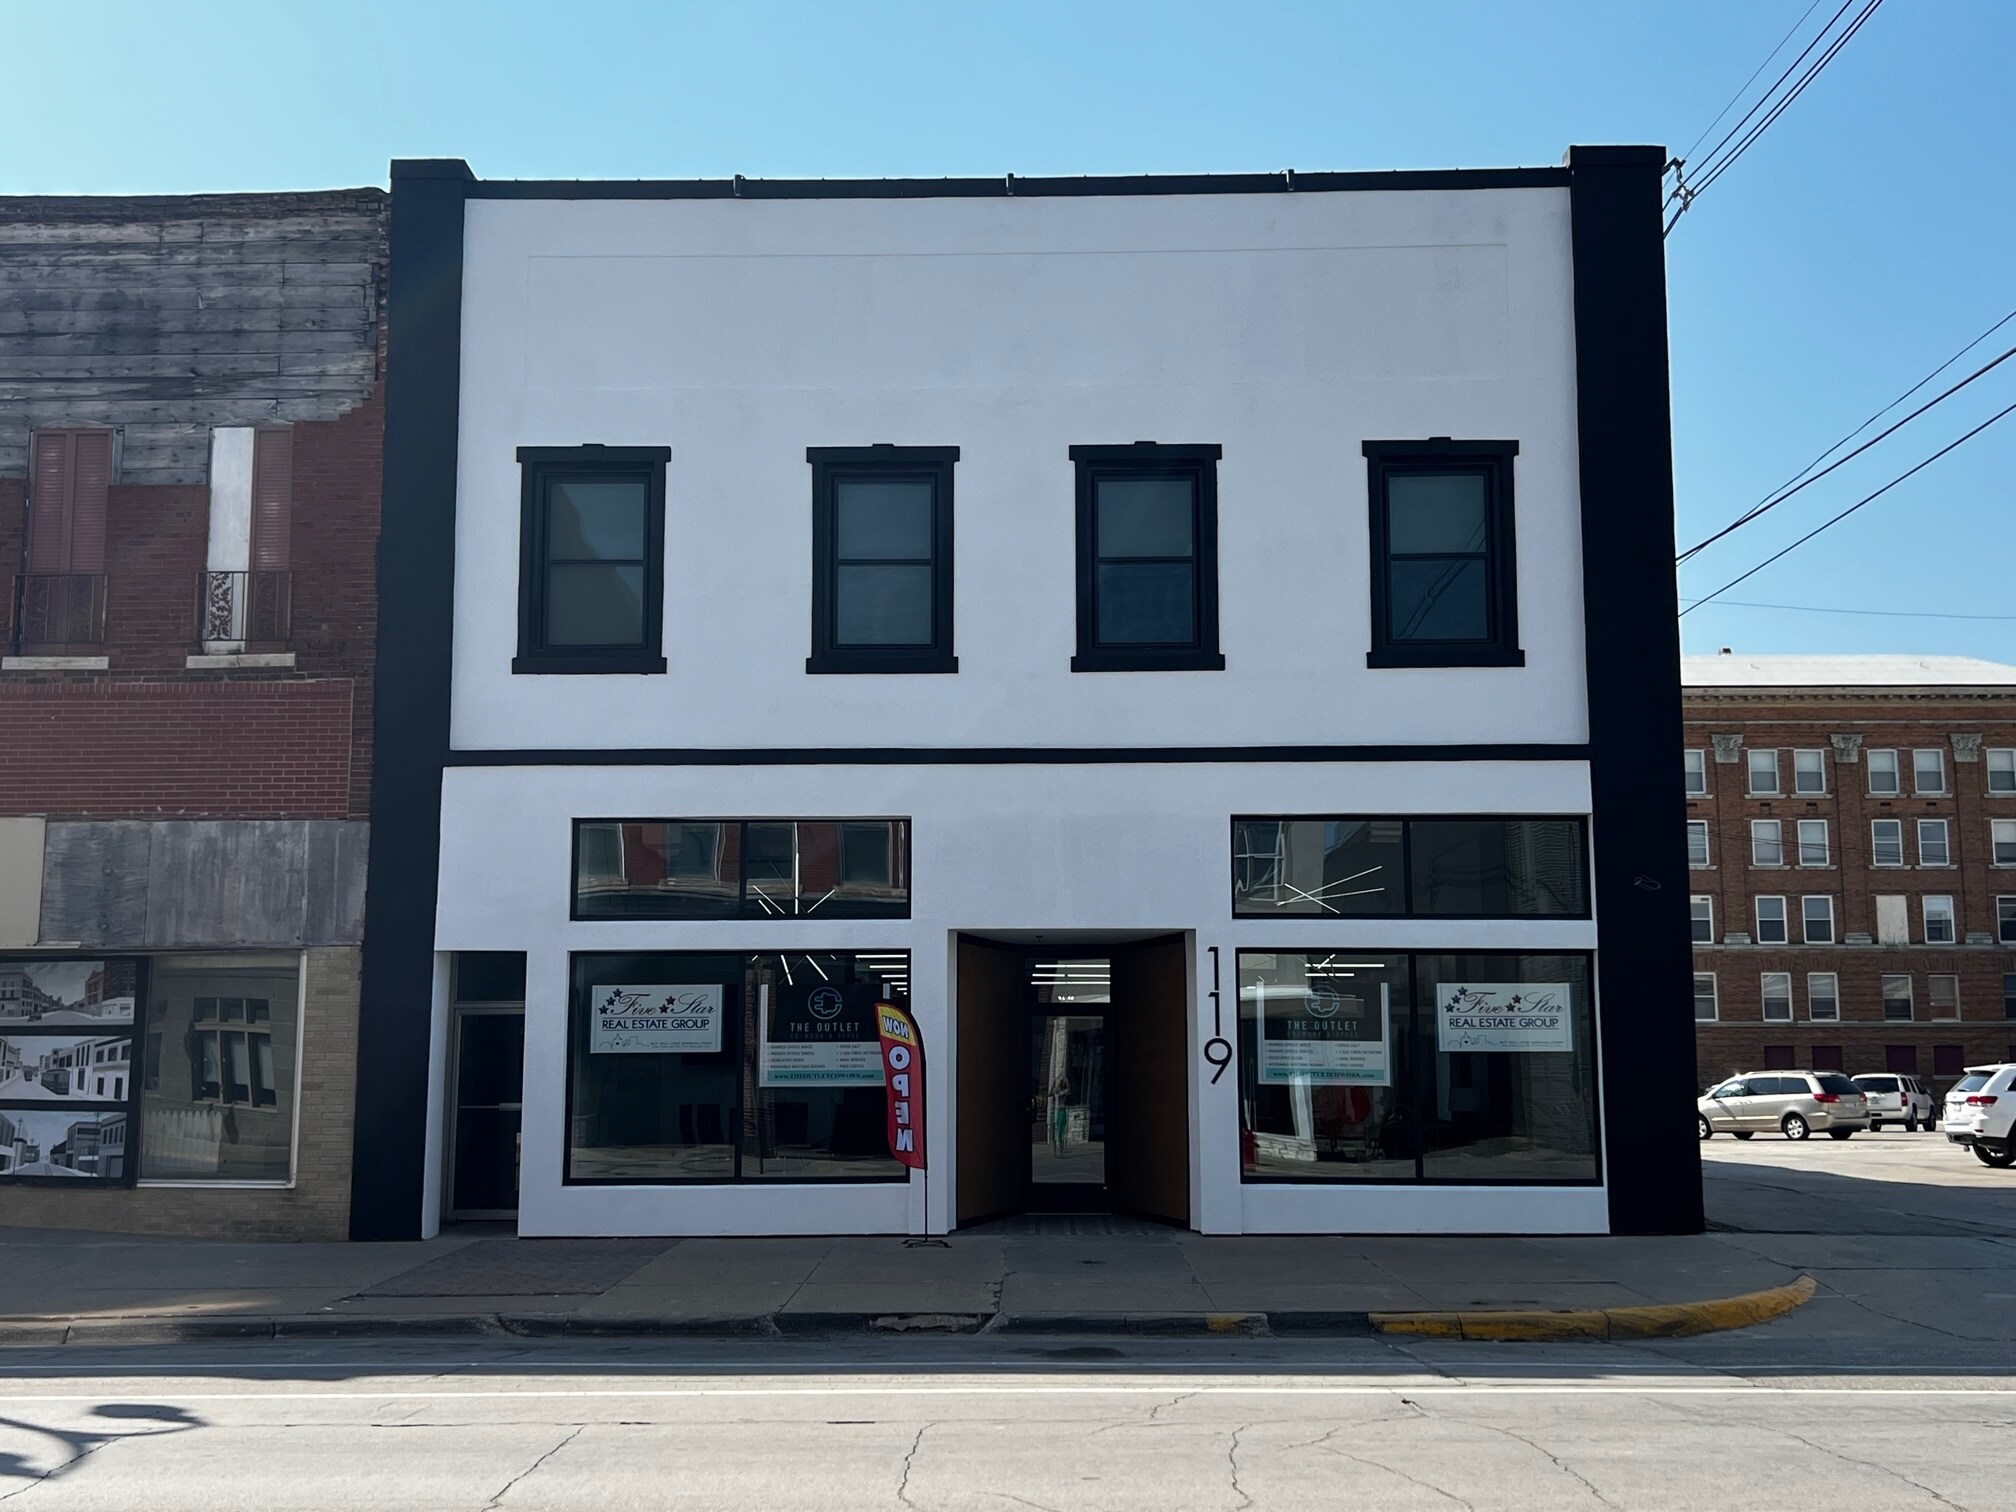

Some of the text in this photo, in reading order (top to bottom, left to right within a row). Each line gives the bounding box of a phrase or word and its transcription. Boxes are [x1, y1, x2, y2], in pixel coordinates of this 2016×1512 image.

[610, 992, 715, 1016] Five Star
[1456, 991, 1564, 1014] Five Star
[1204, 946, 1233, 1085] 119
[602, 1019, 710, 1029] REAL ESTATE GROUP
[790, 1022, 859, 1032] THE OUTLET
[1287, 1020, 1357, 1031] THE OUTLET
[1449, 1018, 1559, 1028] REAL ESTATE GROUP
